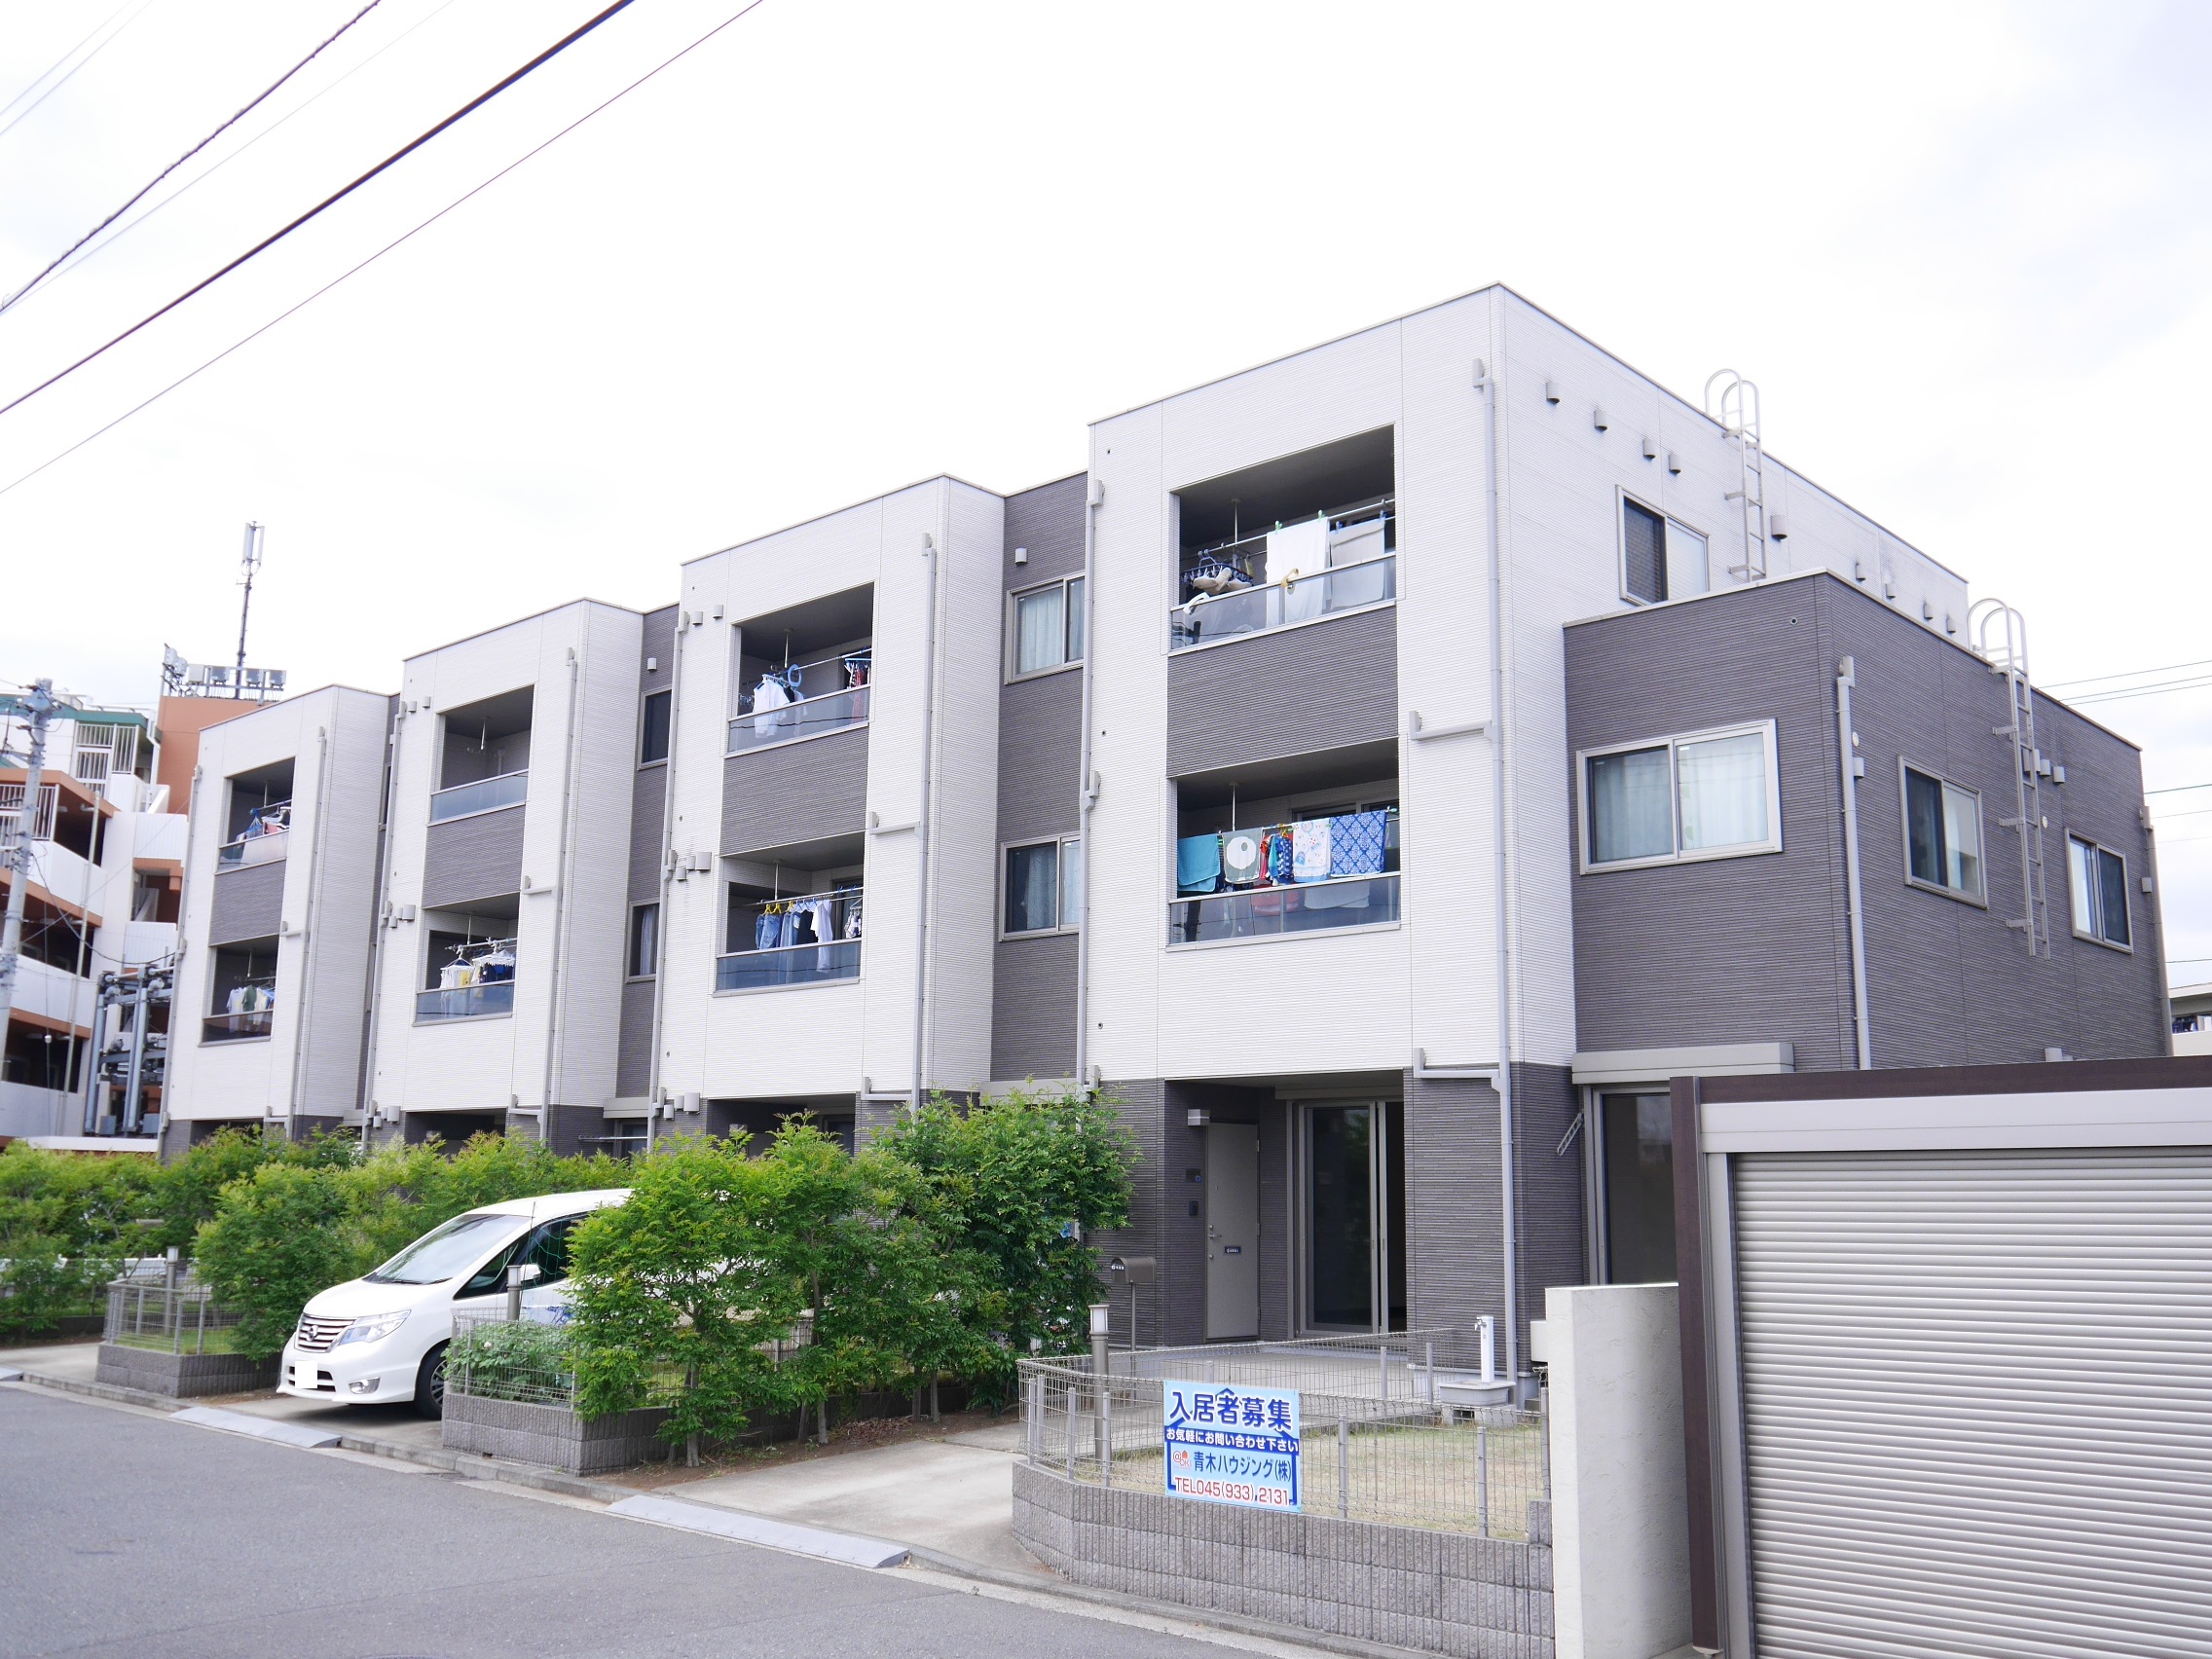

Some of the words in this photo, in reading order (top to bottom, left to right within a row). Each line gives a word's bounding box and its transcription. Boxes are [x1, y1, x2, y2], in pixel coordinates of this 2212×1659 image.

[1169, 1391, 1292, 1430] 入居者募集
[1166, 1428, 1299, 1453] お気軽にお問い合わせ下さい
[1194, 1451, 1292, 1482] 青木ハウジング(株)
